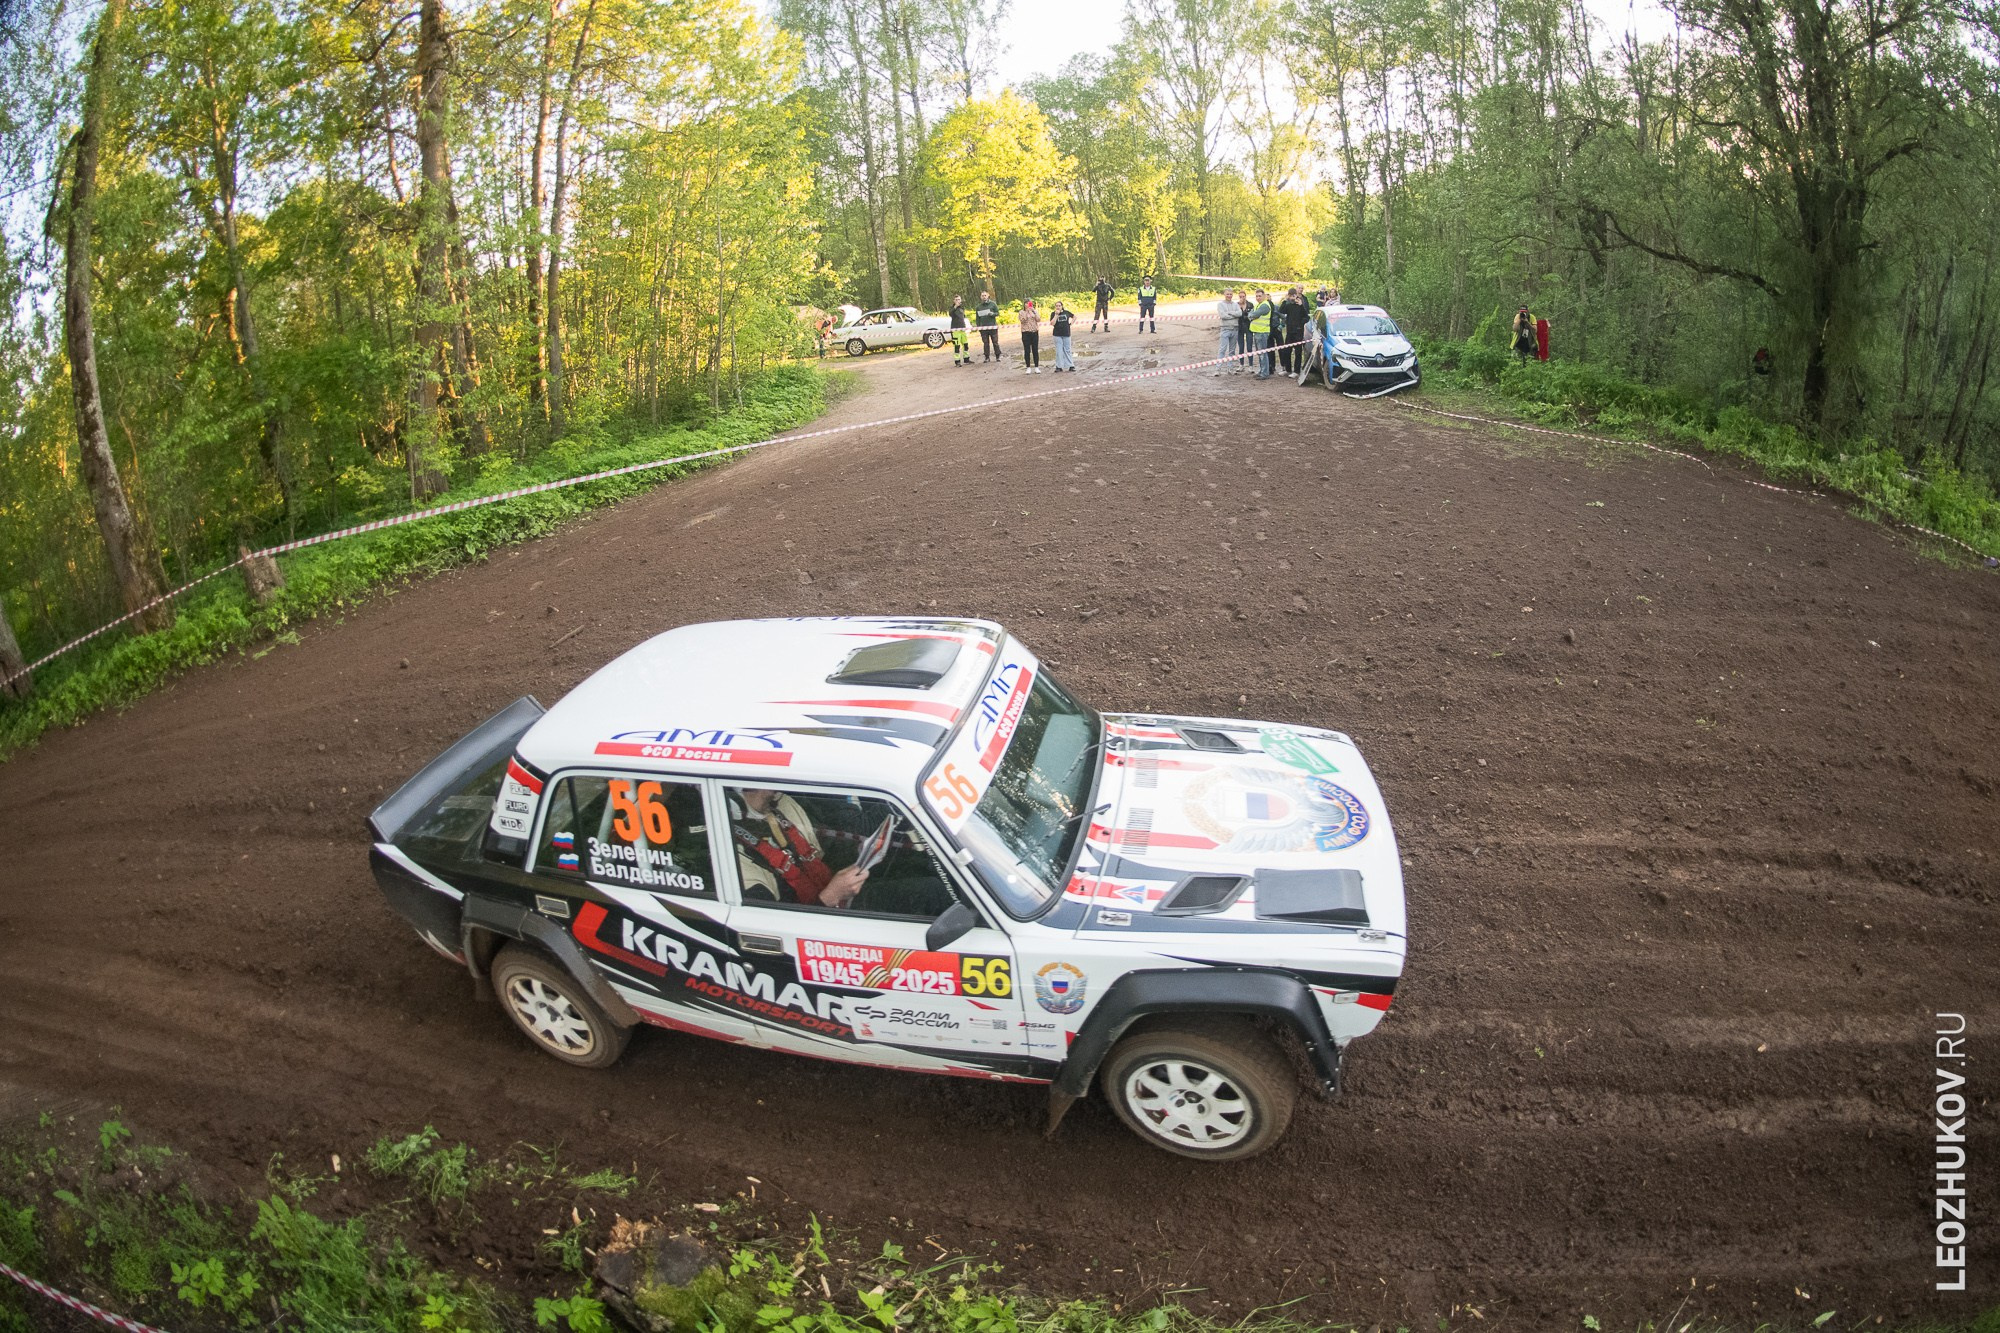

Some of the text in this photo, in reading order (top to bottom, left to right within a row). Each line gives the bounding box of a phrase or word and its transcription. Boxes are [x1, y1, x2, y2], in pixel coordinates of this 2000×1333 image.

[641, 745, 671, 758] ФСО
[924, 763, 979, 819] 56
[608, 780, 673, 844] 56
[588, 837, 674, 867] Зеленин
[590, 857, 705, 891] Балденков
[804, 941, 883, 963] 80 ПОБЕДА!
[623, 918, 856, 1025] KRAMAR
[806, 959, 956, 995] 1945 2025
[961, 957, 1011, 997] 56
[685, 977, 853, 1037] MOTORSPORT
[889, 1017, 960, 1029] РОССИИ
[891, 1008, 950, 1020] РАЛЛИ
